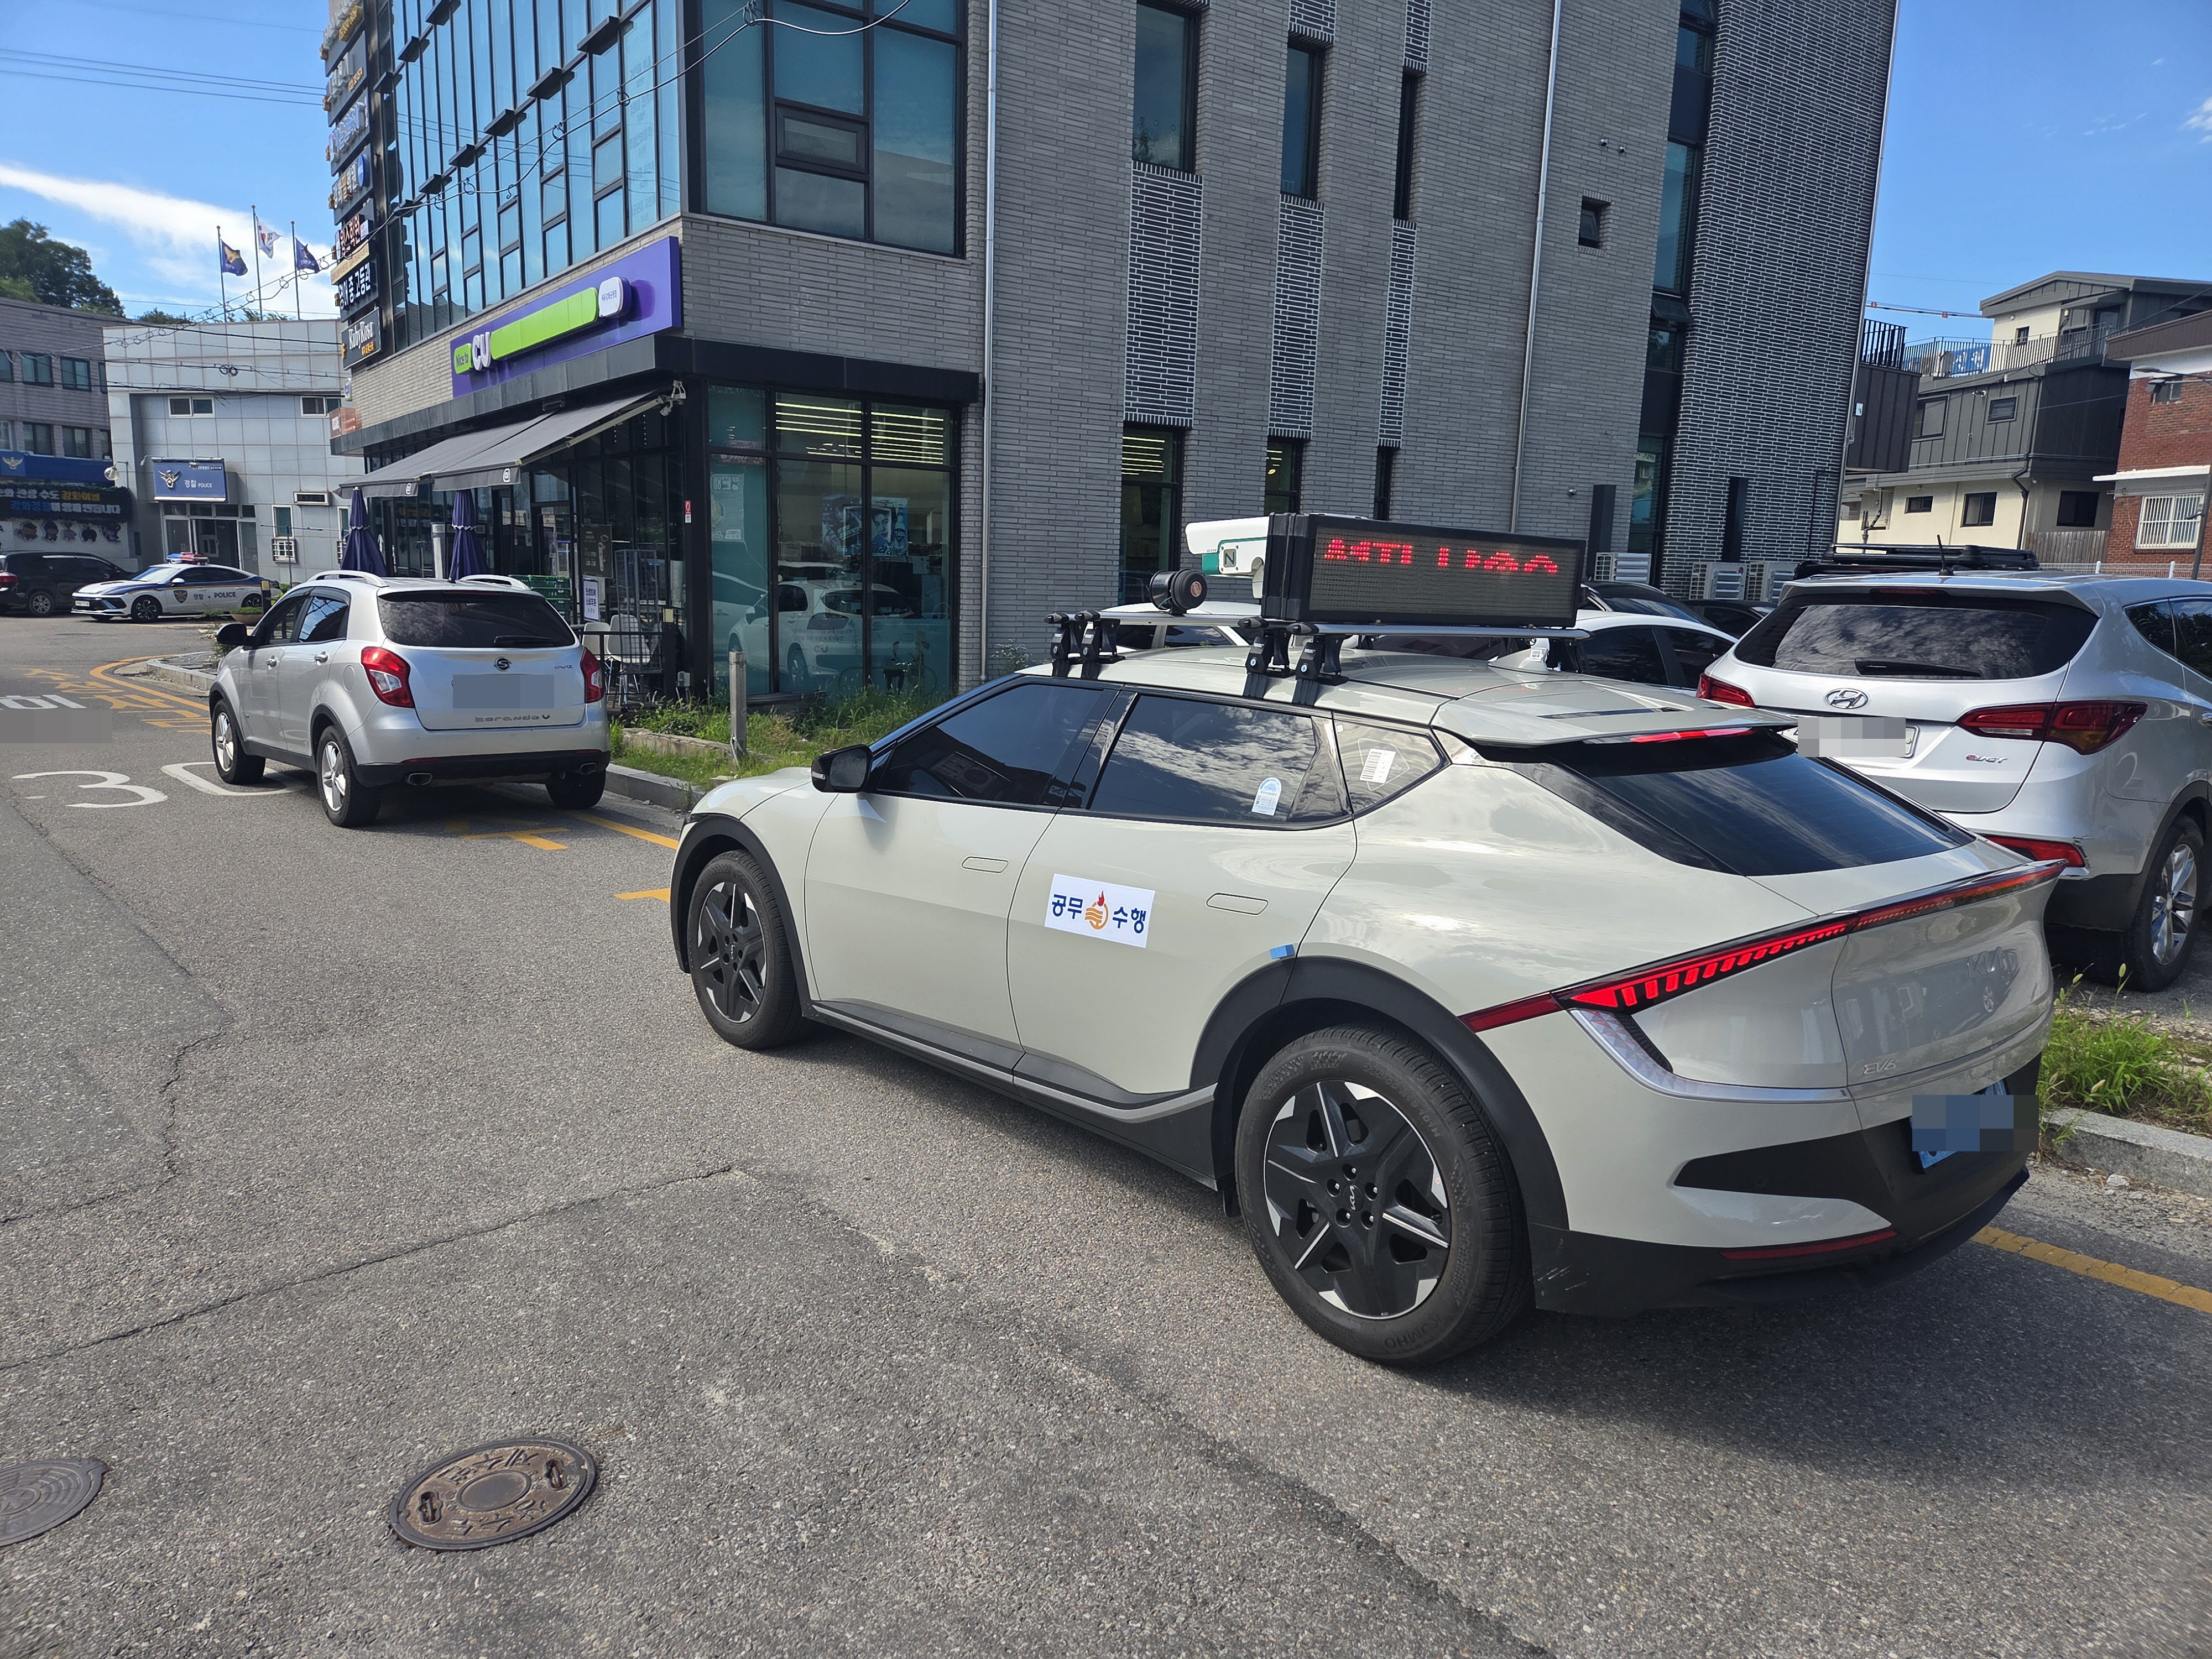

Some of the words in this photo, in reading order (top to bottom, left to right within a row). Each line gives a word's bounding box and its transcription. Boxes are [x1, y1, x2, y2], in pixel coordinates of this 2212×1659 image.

[472, 331, 491, 371] CU
[184, 479, 197, 488] 경찰
[1052, 894, 1083, 920] 공무
[1112, 906, 1146, 934] 수행
[1863, 1058, 1896, 1076] EV6
